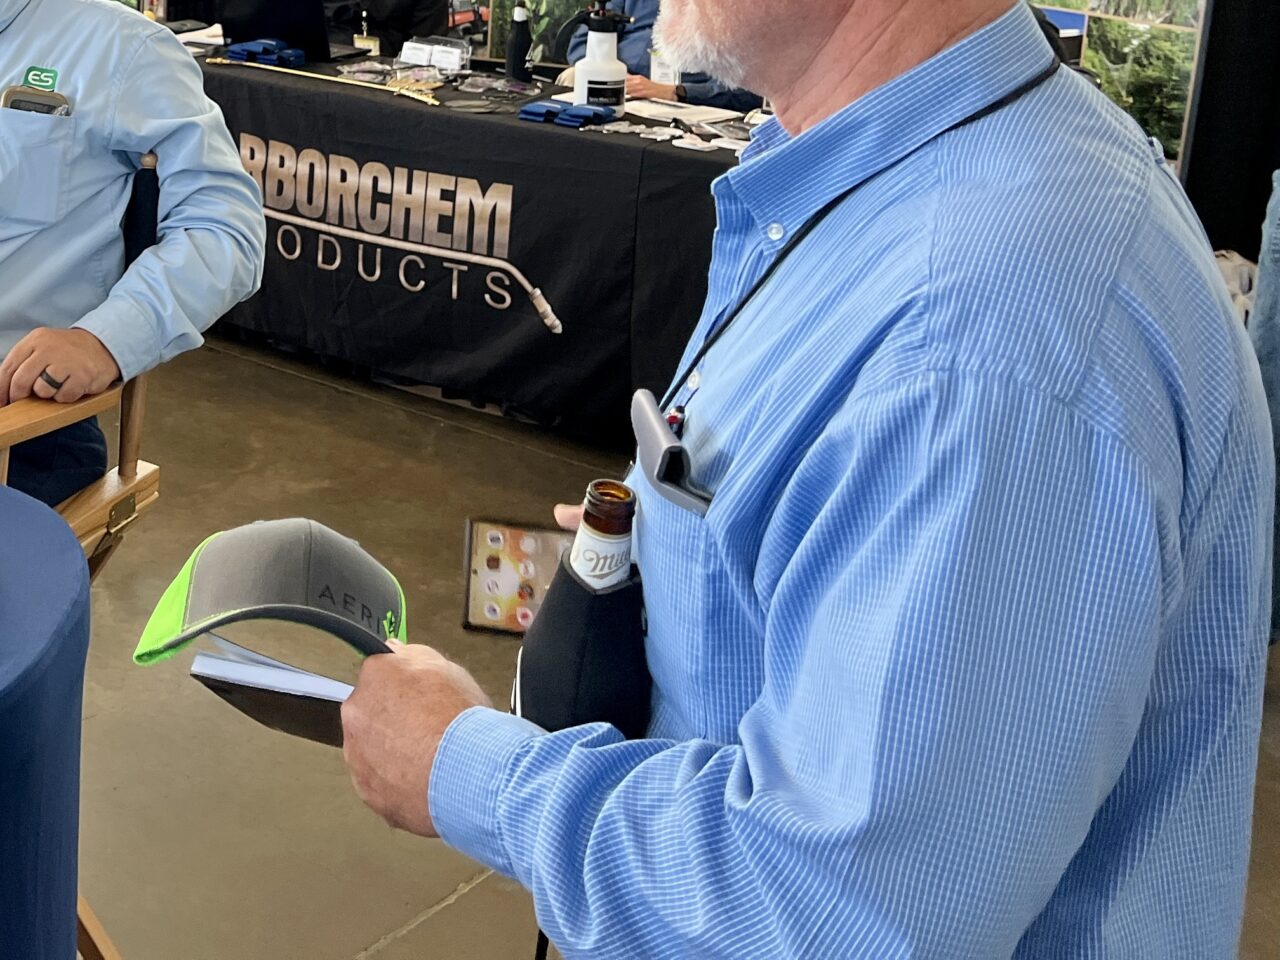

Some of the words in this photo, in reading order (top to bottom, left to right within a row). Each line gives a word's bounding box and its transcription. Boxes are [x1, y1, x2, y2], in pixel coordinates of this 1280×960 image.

[28, 70, 54, 86] ES
[240, 132, 514, 259] RBORCHEM
[276, 224, 512, 310] ODUCTS
[318, 584, 380, 635] AERI
